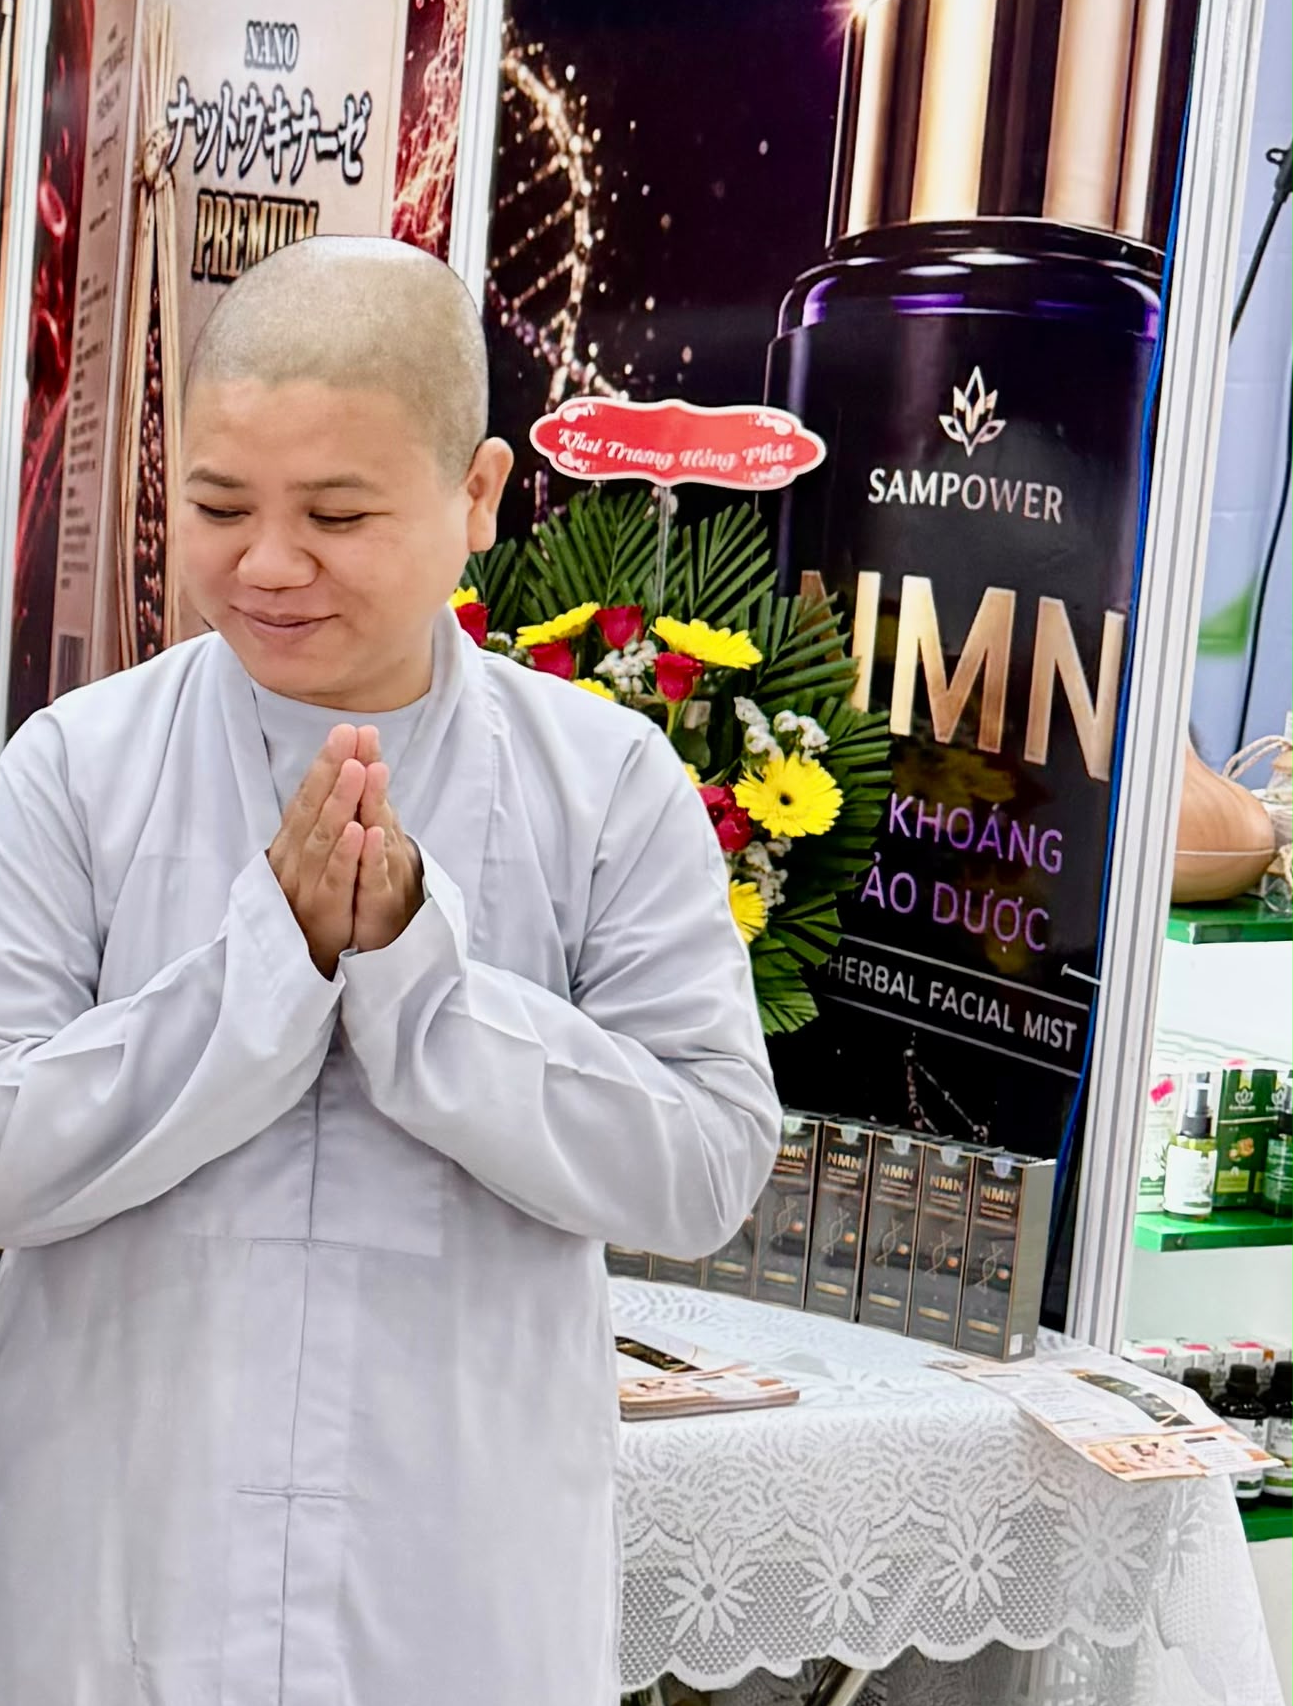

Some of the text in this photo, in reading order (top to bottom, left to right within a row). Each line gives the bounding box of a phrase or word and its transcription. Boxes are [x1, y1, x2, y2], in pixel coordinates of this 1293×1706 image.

[244, 19, 300, 70] NANO
[165, 76, 373, 185] ナットウキナーゼ
[868, 467, 1063, 524] SAMPOWER
[888, 793, 1063, 875] KHOÁNG
[860, 851, 1049, 953] ẢO DƯỢC
[827, 953, 1078, 1053] HERBAL FACIAL MIST
[826, 1151, 862, 1171] NMN
[879, 1162, 914, 1181] NMN
[929, 1174, 964, 1192] NMN
[980, 1184, 1017, 1204] NMN
